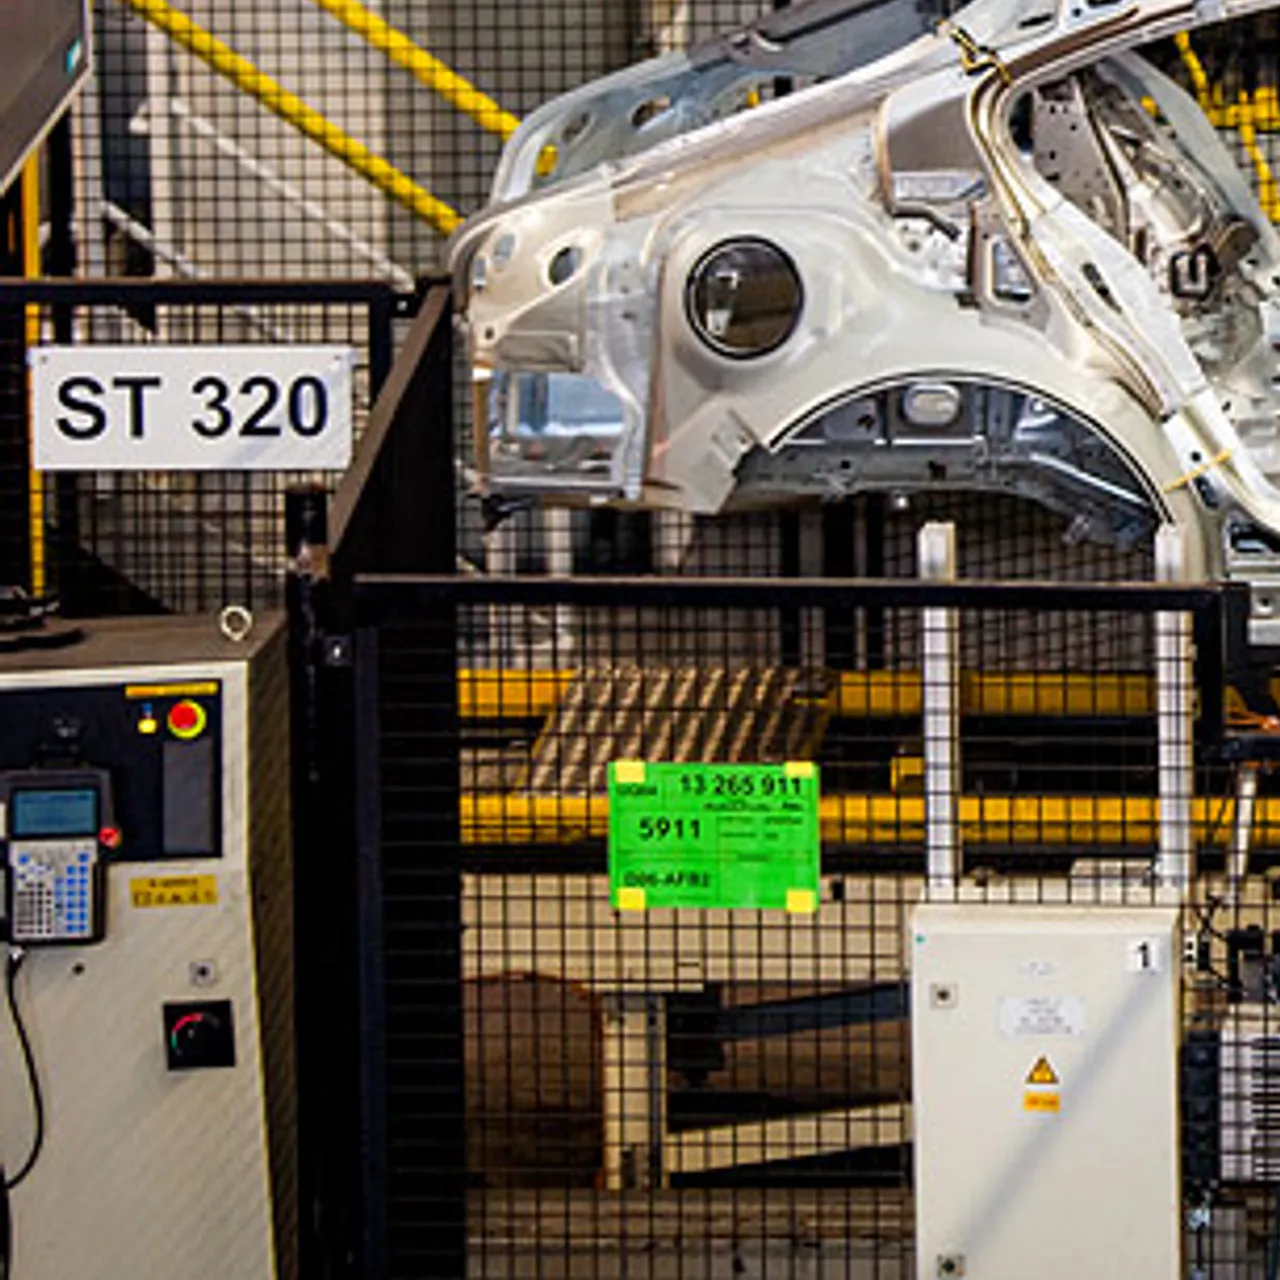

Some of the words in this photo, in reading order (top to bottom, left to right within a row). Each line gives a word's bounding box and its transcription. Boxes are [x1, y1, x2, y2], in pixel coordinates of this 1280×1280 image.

[56, 376, 161, 440] ST
[191, 375, 328, 439] 320
[639, 816, 700, 841] 5911
[1137, 941, 1150, 969] 1
